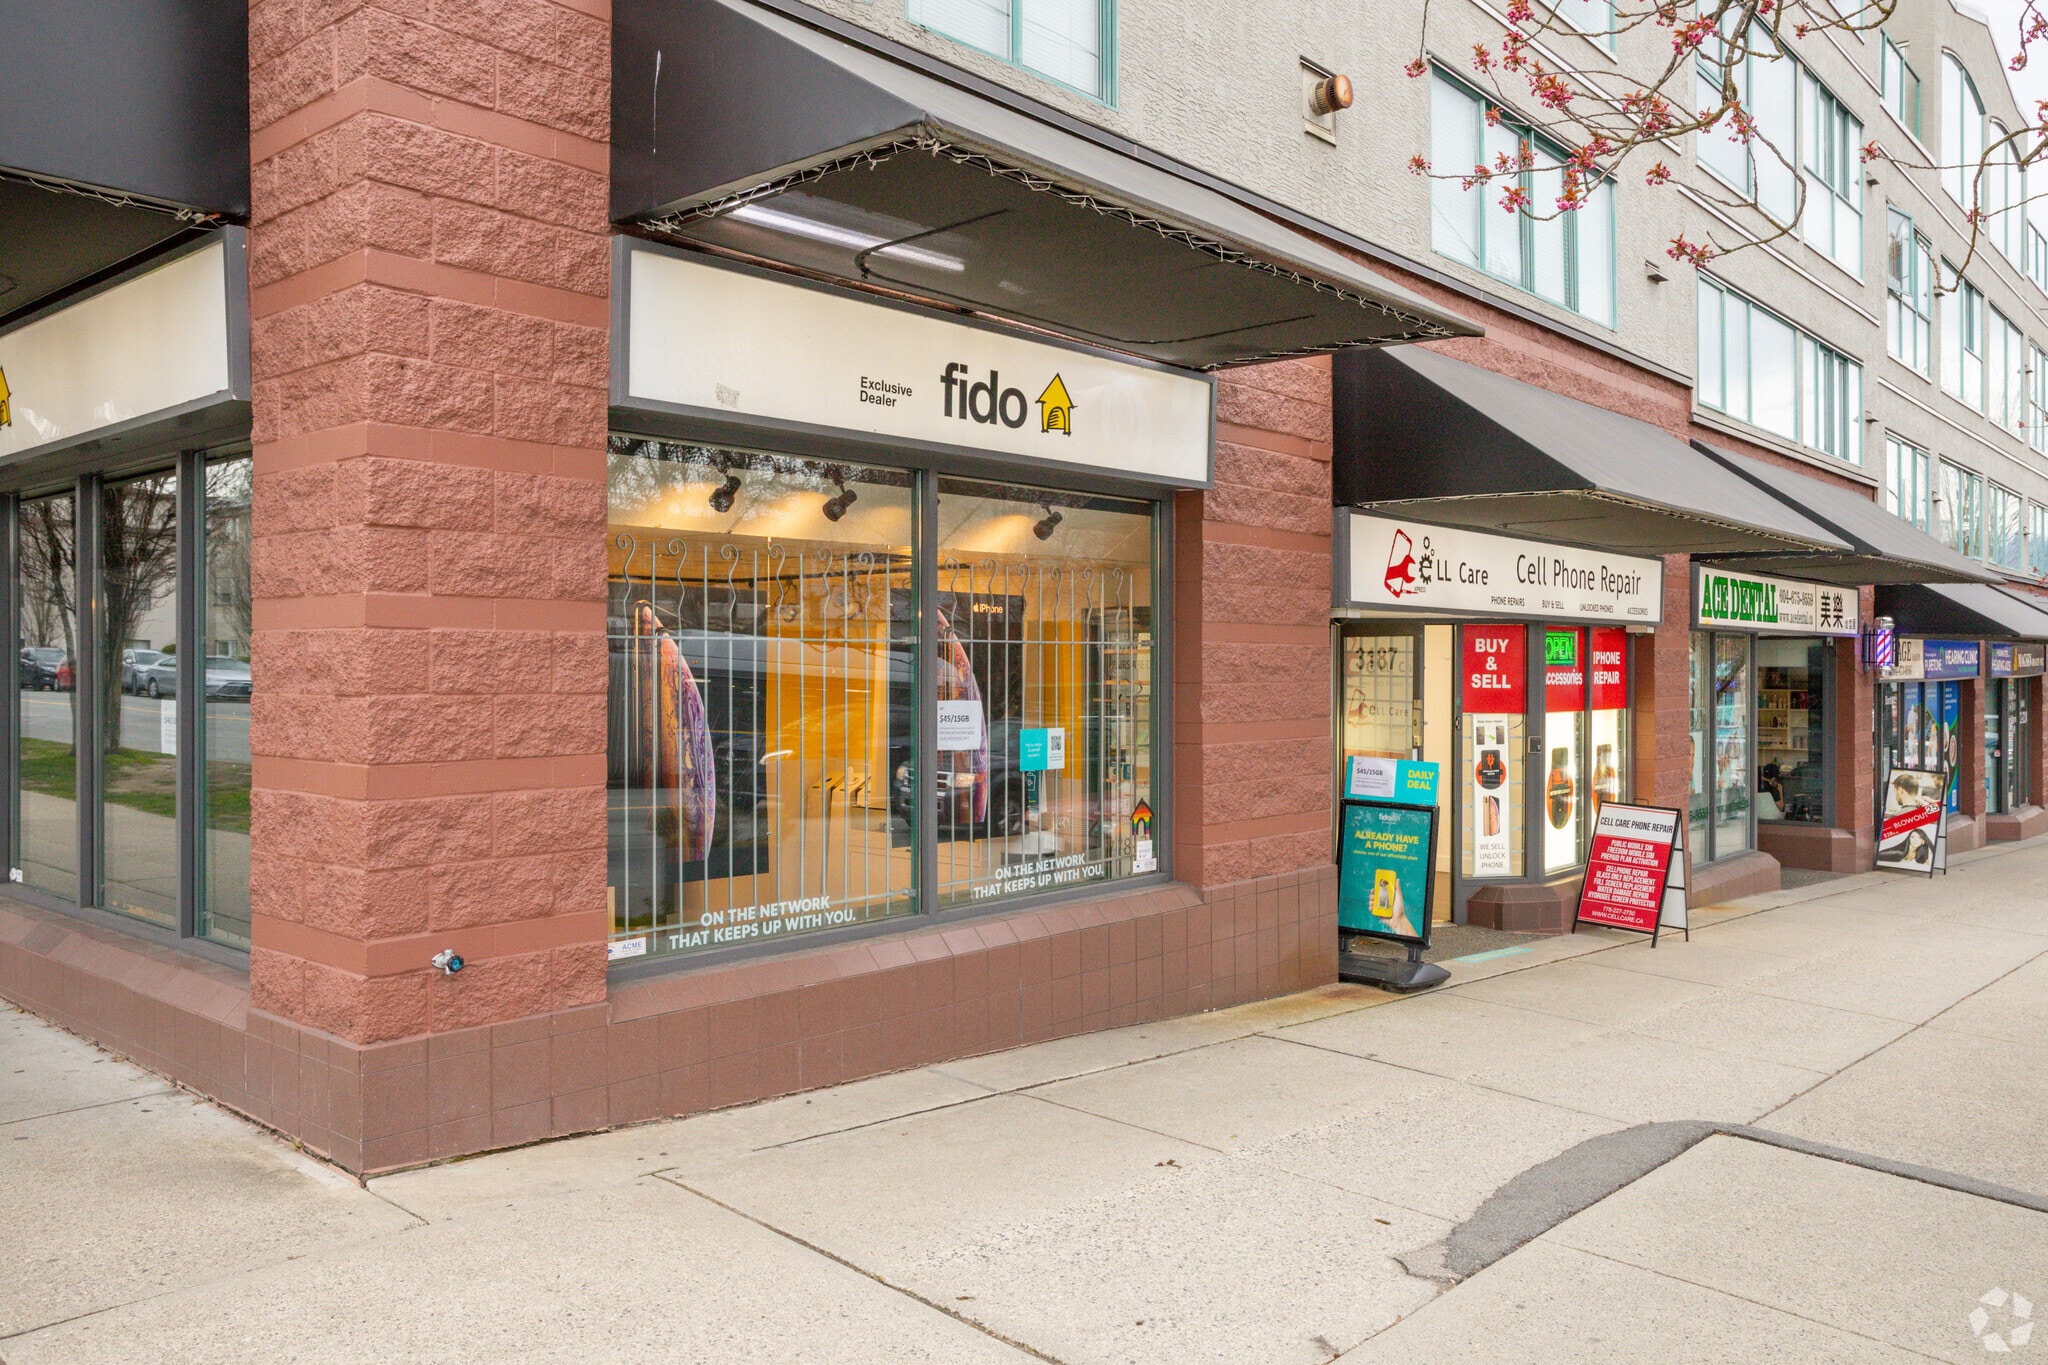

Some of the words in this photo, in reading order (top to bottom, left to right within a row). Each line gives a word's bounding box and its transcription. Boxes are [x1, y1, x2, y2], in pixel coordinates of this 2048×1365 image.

[860, 376, 913, 397] Exclusive
[860, 390, 897, 407] Dealer
[940, 362, 1027, 429] fido
[1459, 561, 1489, 585] Care
[1516, 554, 1547, 586] Cell
[1553, 559, 1595, 591] Phone
[1601, 565, 1641, 600] Repair
[1491, 595, 1507, 606] PHONE
[1507, 597, 1525, 607] REPAIRS
[1542, 599, 1551, 609] BUY
[1555, 600, 1565, 610] SELL
[1701, 574, 1729, 619] ACE
[1730, 578, 1778, 623] DENTAL
[980, 603, 1003, 613] iPhone
[1475, 638, 1510, 653] BUY
[1546, 637, 1573, 660] OPEN
[1356, 647, 1398, 670] 3187
[1485, 656, 1498, 671] &
[1593, 651, 1620, 665] IPHONE
[1471, 674, 1511, 689] SELL
[1594, 671, 1620, 685] REPAIR
[939, 714, 970, 723] $45/15GB
[1356, 767, 1384, 776] $45/15GB
[1408, 769, 1435, 780] DAILY
[1407, 780, 1431, 790] DEAL
[1926, 804, 1939, 813] 25
[1600, 817, 1614, 827] CELL
[1615, 818, 1630, 828] CARE
[1631, 820, 1651, 831] PHONE
[1652, 823, 1674, 834] REPAIR
[1893, 812, 1928, 829] BLOWOUT
[1355, 830, 1395, 842] ALREADY
[1396, 834, 1419, 844] HAVE
[1373, 842, 1408, 852] PHONE?
[1491, 842, 1505, 850] SELL
[1611, 839, 1627, 848] PUBLIC
[1627, 841, 1644, 850] MOBILE
[1600, 852, 1620, 861] PREPAID
[1620, 854, 1632, 863] PLAN
[1632, 856, 1659, 867] ACTIVATION
[1607, 846, 1628, 855] FREEDOM
[1628, 849, 1645, 857] MOBILE
[1645, 851, 1655, 859] SIM
[995, 868, 1012, 880] ON
[1014, 862, 1034, 877] THE
[1036, 853, 1086, 873] NETWORK
[1481, 861, 1504, 869] PHONE
[1605, 865, 1631, 875] CELLPHONE
[1632, 868, 1648, 877] REPAIR
[974, 883, 1001, 899] THAT
[1004, 877, 1036, 893] KEEPS
[1038, 873, 1051, 886] UP
[1054, 868, 1080, 883] WITH
[1082, 864, 1104, 879] YOU.
[1596, 870, 1611, 879] GLASS
[1611, 873, 1622, 881] ONLY
[1622, 875, 1656, 885] REPLACEMENT
[1593, 878, 1605, 886] FULL
[1605, 879, 1622, 887] SCREEN
[1622, 882, 1655, 893] REPLACEMENT
[1597, 885, 1613, 894] WATER
[1613, 888, 1633, 897] DAMAGE
[1633, 891, 1649, 899] REPAIR
[1611, 895, 1629, 904] SCREEN
[1629, 898, 1656, 908] PROTECTOR
[700, 912, 718, 927] ON
[728, 905, 756, 922] THE
[759, 895, 830, 919] NETWORK
[669, 930, 710, 950] THAT
[714, 923, 758, 943] KEEPS
[763, 919, 782, 935] UP
[785, 913, 822, 931] WITH
[824, 909, 856, 925] YOU.
[622, 940, 643, 951] ACME
